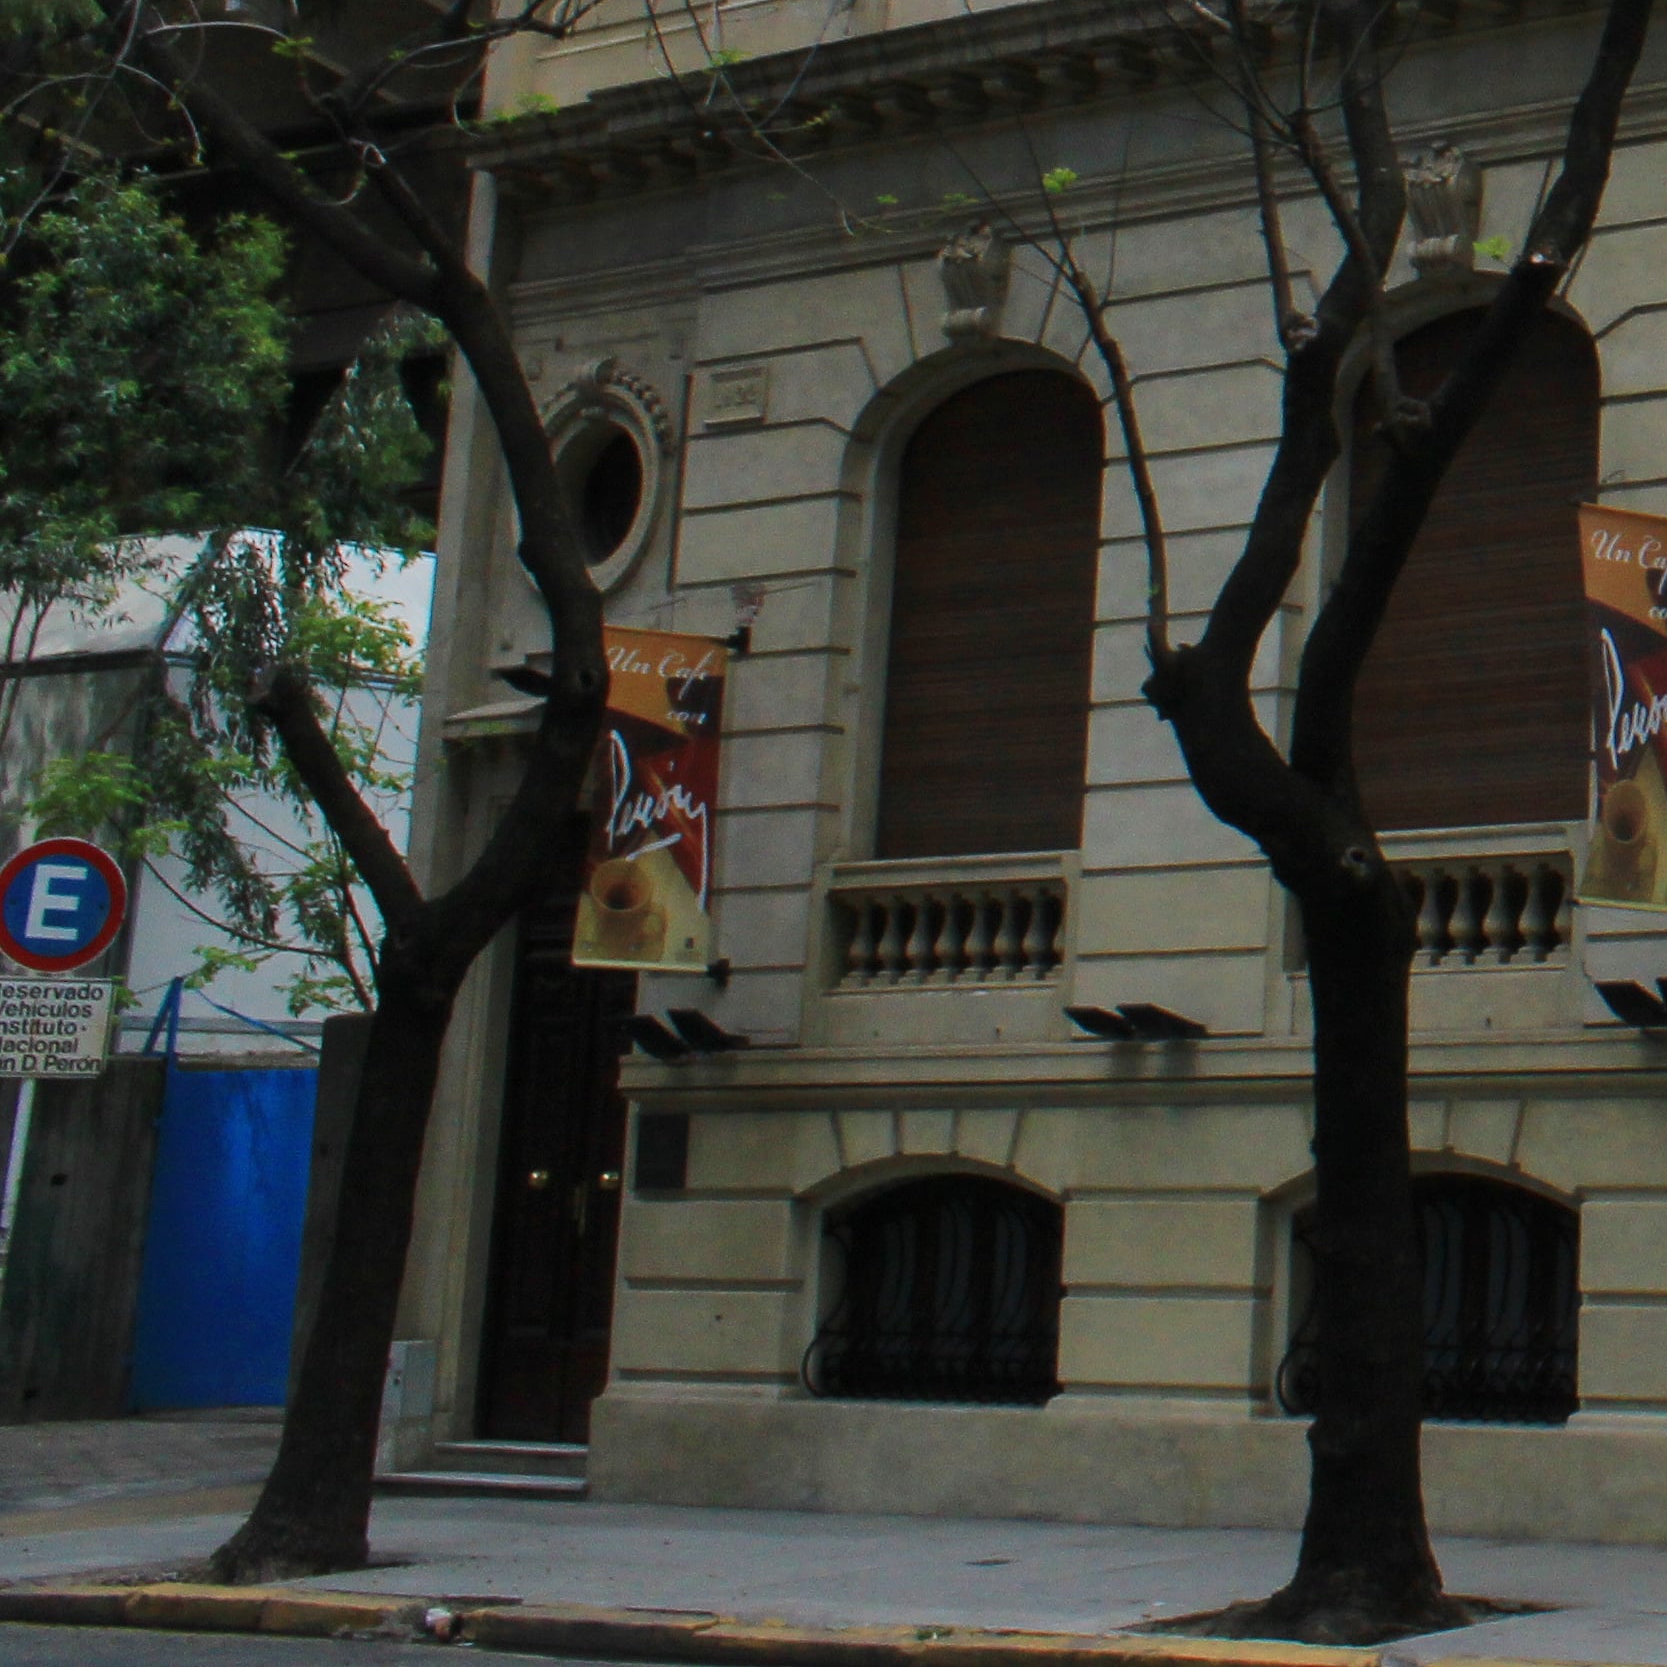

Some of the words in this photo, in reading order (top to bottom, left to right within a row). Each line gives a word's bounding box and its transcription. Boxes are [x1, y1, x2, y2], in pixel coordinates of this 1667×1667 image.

[1591, 529, 1632, 563] Un
[607, 646, 651, 675] Un
[25, 863, 88, 941] E
[0, 983, 104, 1001] eservado
[0, 1036, 78, 1053] acional
